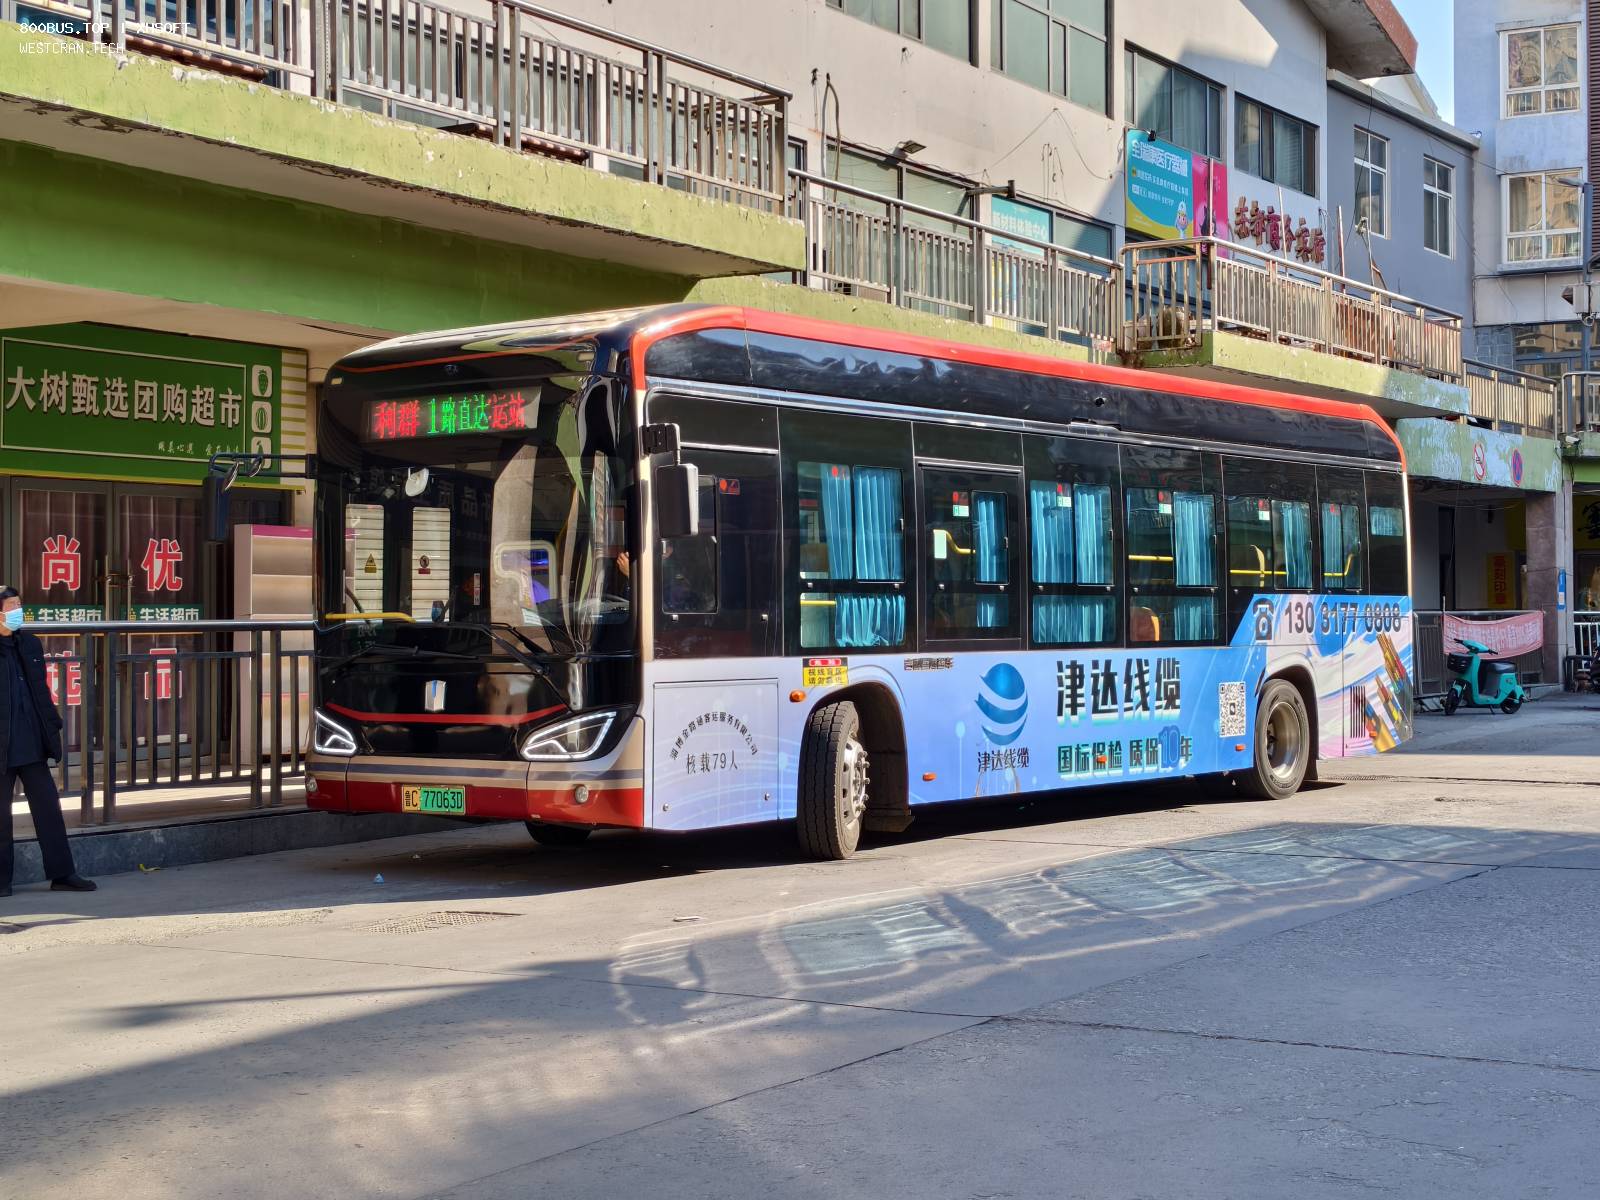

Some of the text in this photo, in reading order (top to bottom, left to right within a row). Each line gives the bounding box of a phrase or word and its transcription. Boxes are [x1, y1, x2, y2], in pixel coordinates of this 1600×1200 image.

[6, 365, 243, 429] 大树甄选团购超市
[41, 534, 81, 590] 尚
[141, 538, 183, 591] 优
[1285, 601, 1315, 634] 130
[1056, 657, 1181, 717] 津达线缆
[686, 750, 738, 774] 核载79人
[977, 747, 1030, 772] 津达线缆
[1057, 740, 1122, 774] 国标保检
